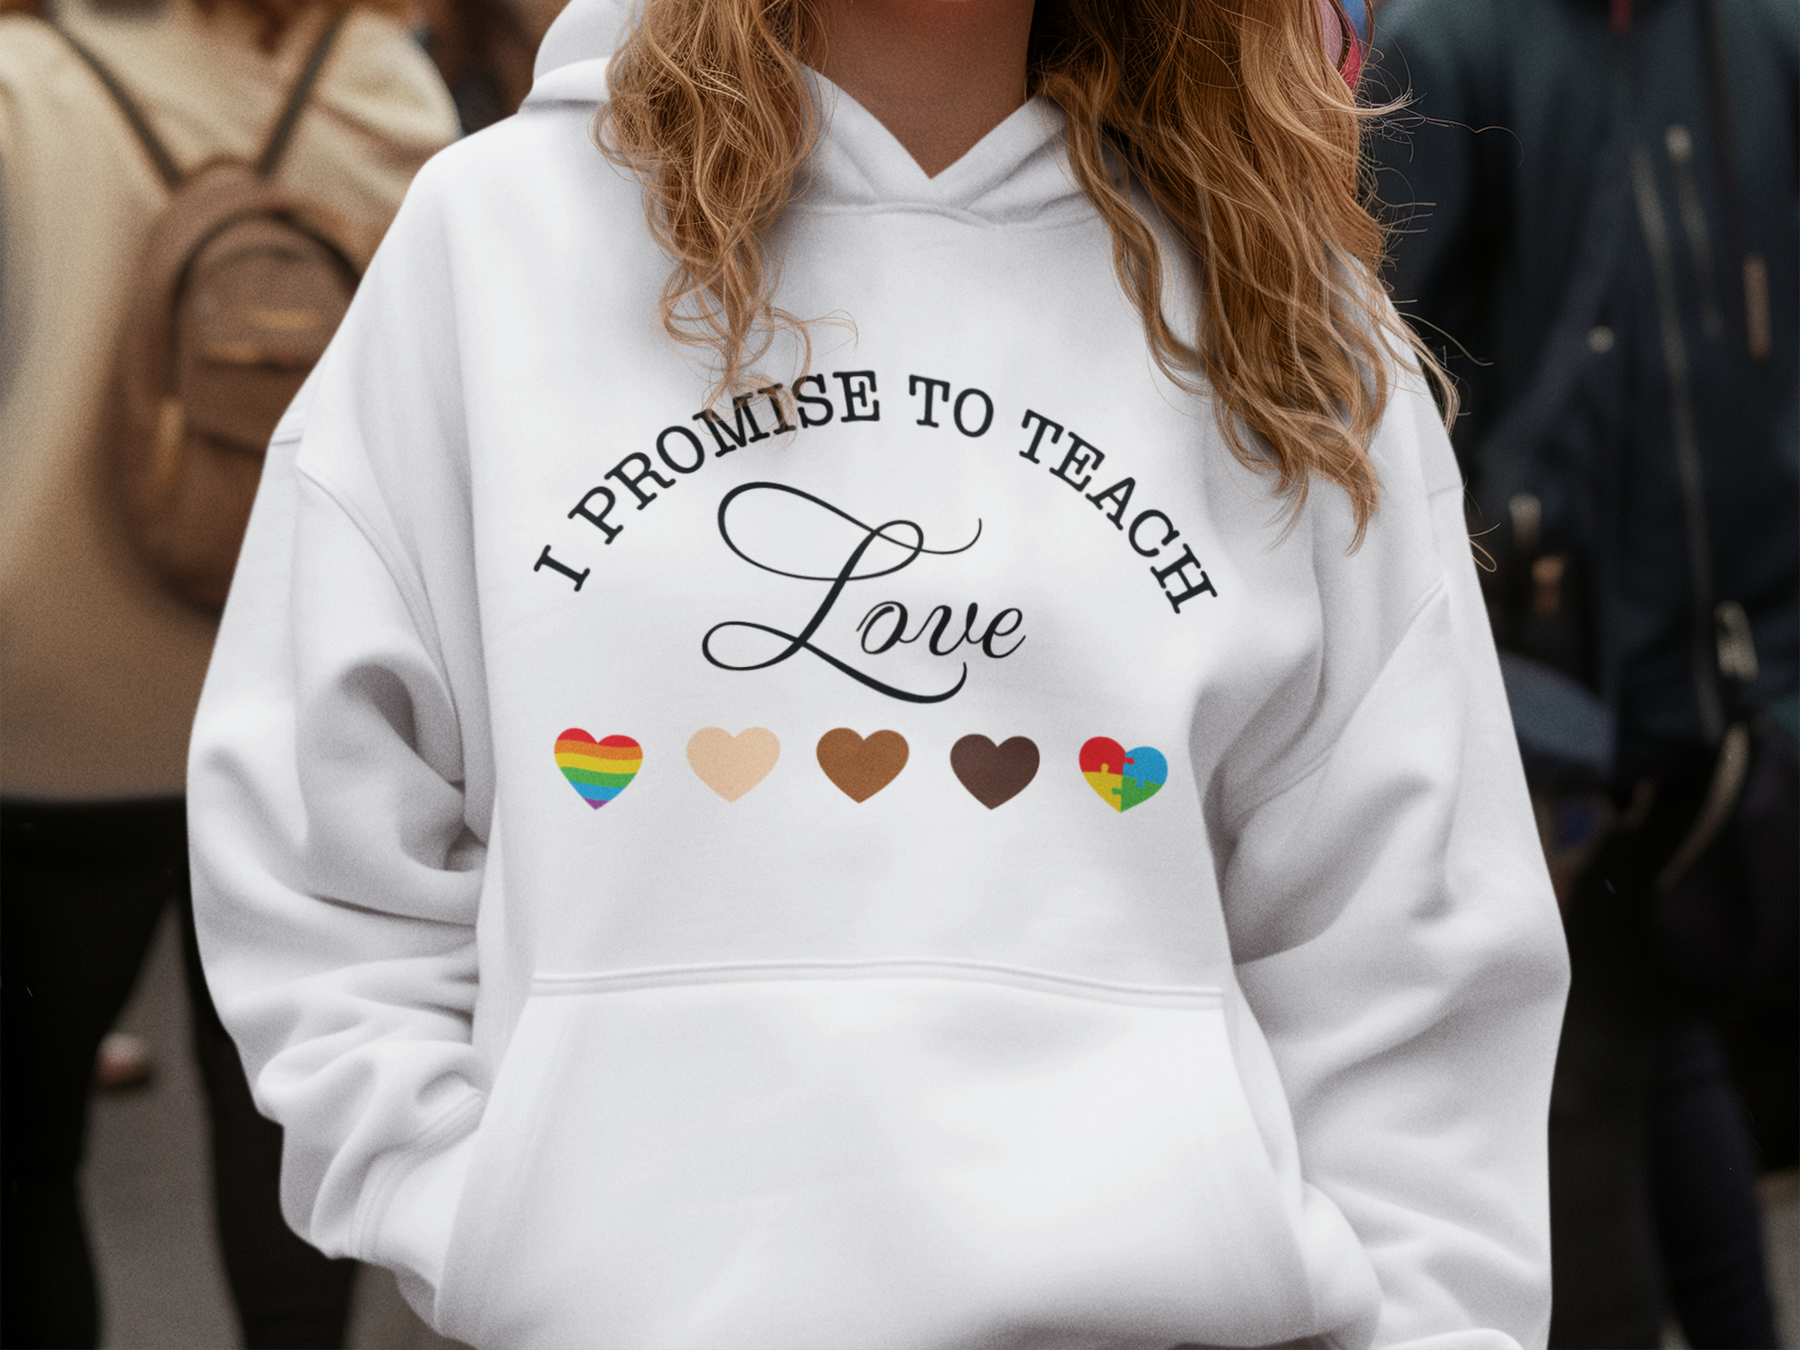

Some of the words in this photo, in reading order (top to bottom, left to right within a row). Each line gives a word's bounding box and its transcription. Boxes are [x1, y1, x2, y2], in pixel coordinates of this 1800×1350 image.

[533, 544, 591, 592] I
[567, 370, 880, 545] PROMISE
[908, 374, 994, 438] TO
[1019, 409, 1218, 614] TEACH
[701, 481, 1026, 704] Love
